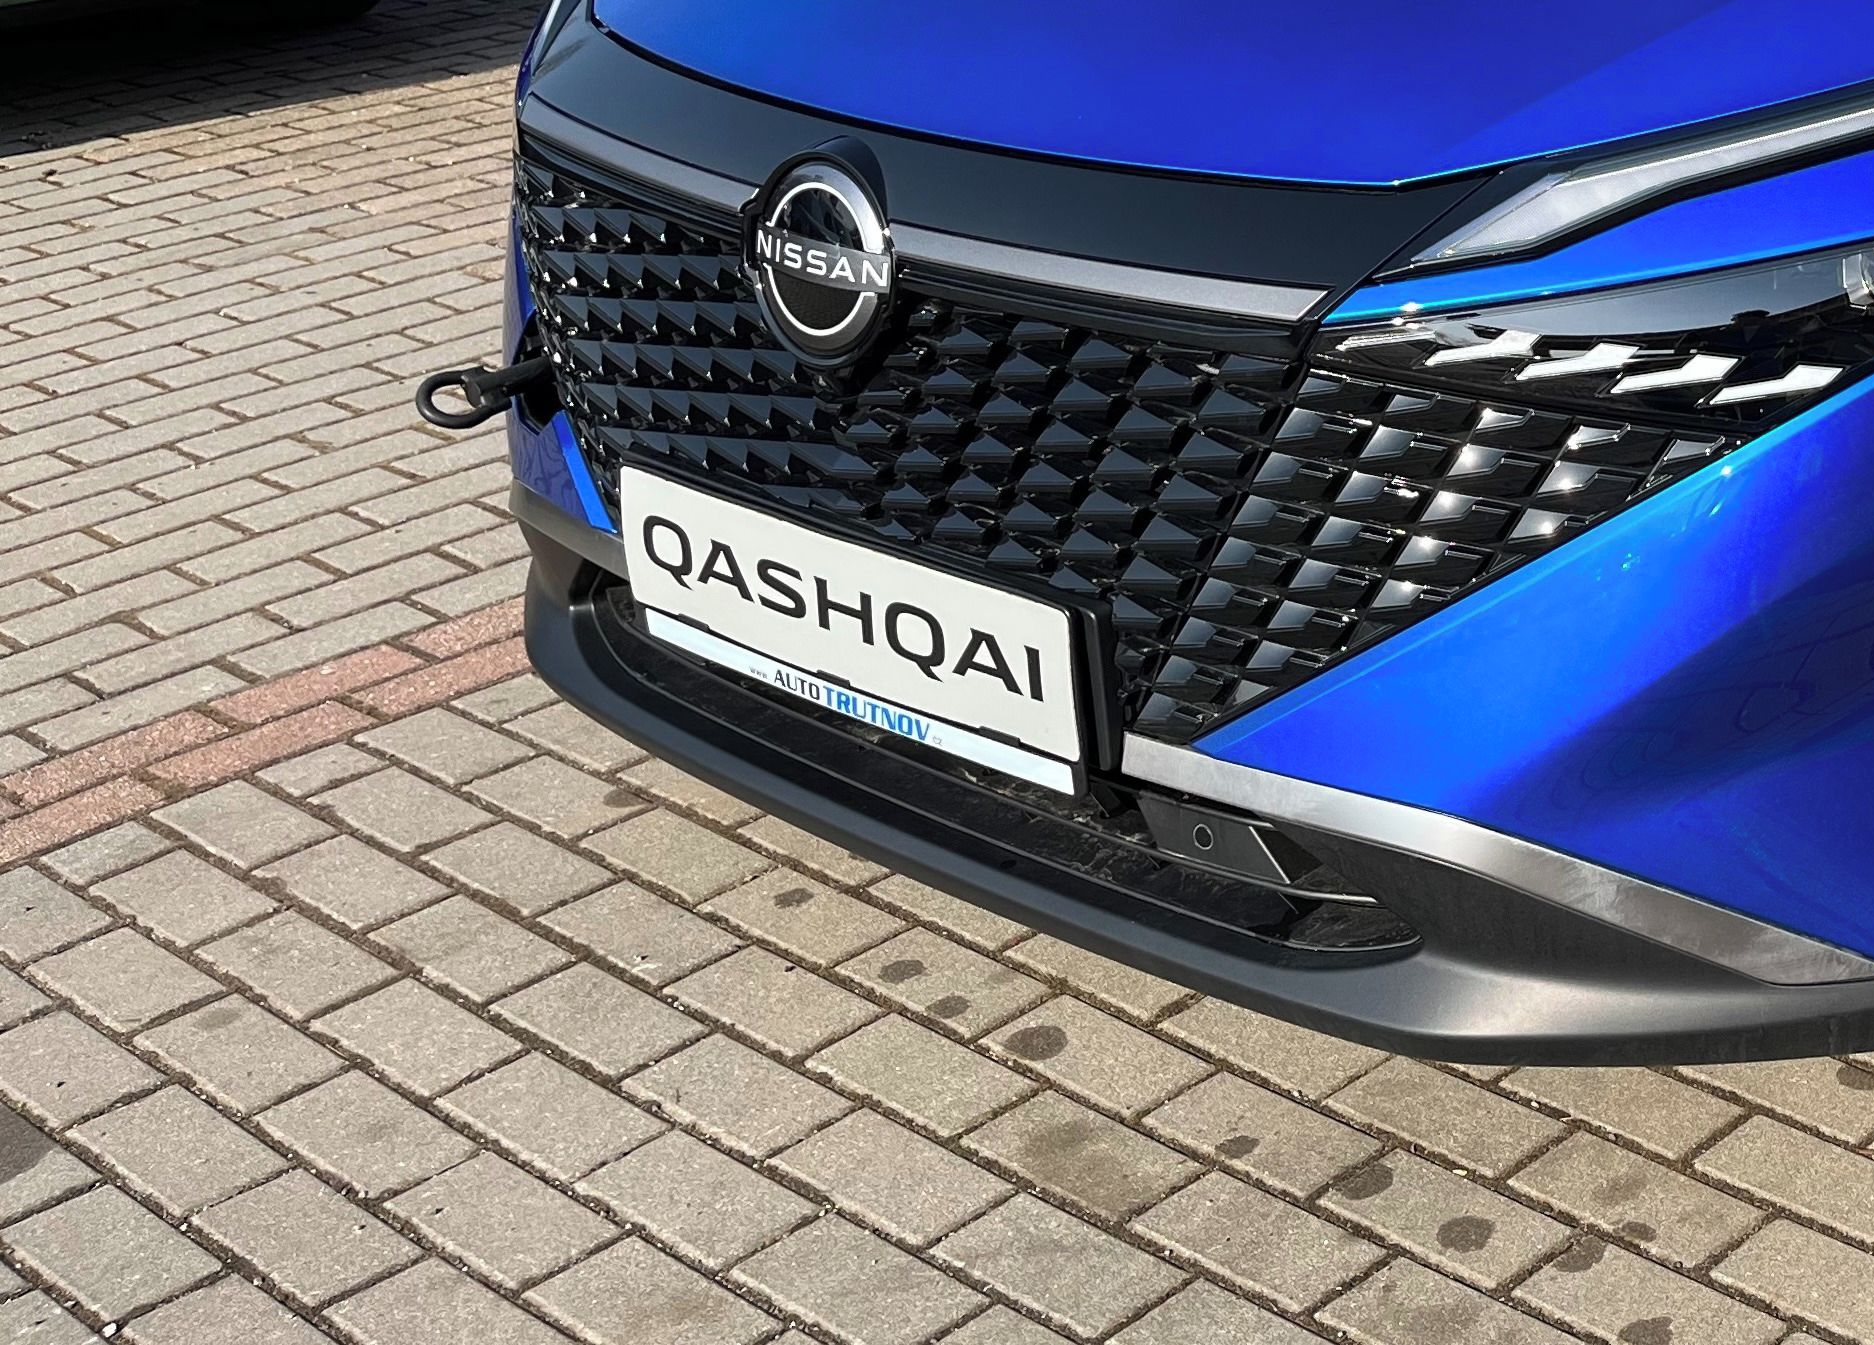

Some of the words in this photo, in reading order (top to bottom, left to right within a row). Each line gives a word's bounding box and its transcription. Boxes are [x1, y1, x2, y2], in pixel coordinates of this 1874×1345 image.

[757, 229, 888, 287] NISSAN
[643, 515, 1044, 702] QASHQAI
[823, 685, 930, 741] TRUTNOV
